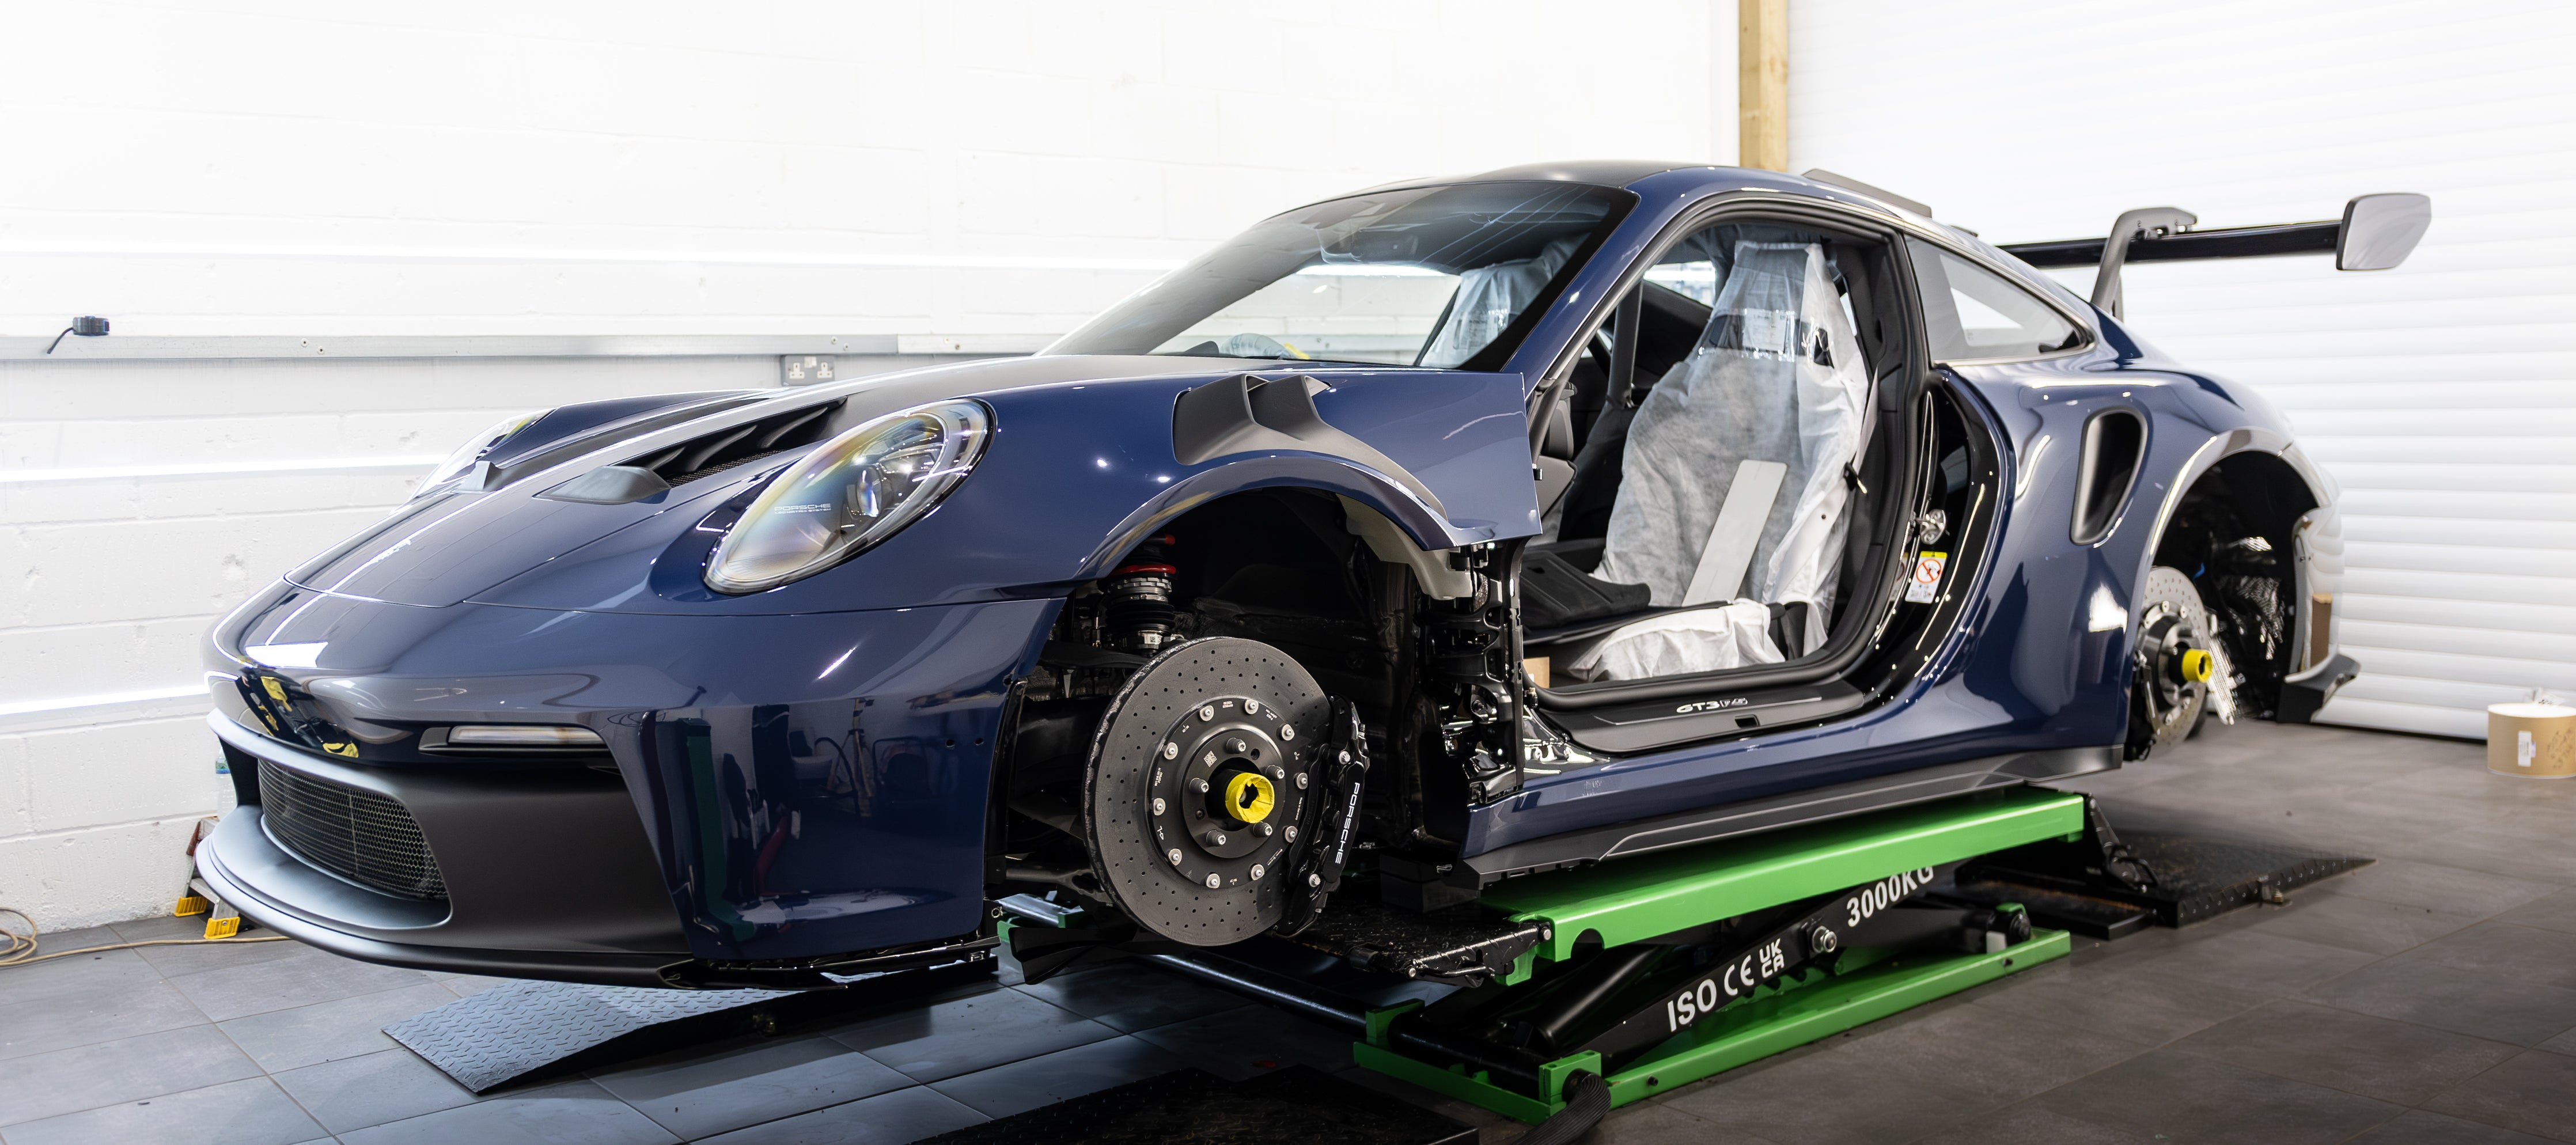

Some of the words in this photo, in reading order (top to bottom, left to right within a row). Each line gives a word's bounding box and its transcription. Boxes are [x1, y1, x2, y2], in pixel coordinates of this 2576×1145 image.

[1335, 782, 1360, 864] PORSCHE
[1759, 938, 1782, 964] UK
[1761, 954, 1785, 978] CA
[1668, 979, 1717, 1032] ISO
[1724, 954, 1754, 996] CE
